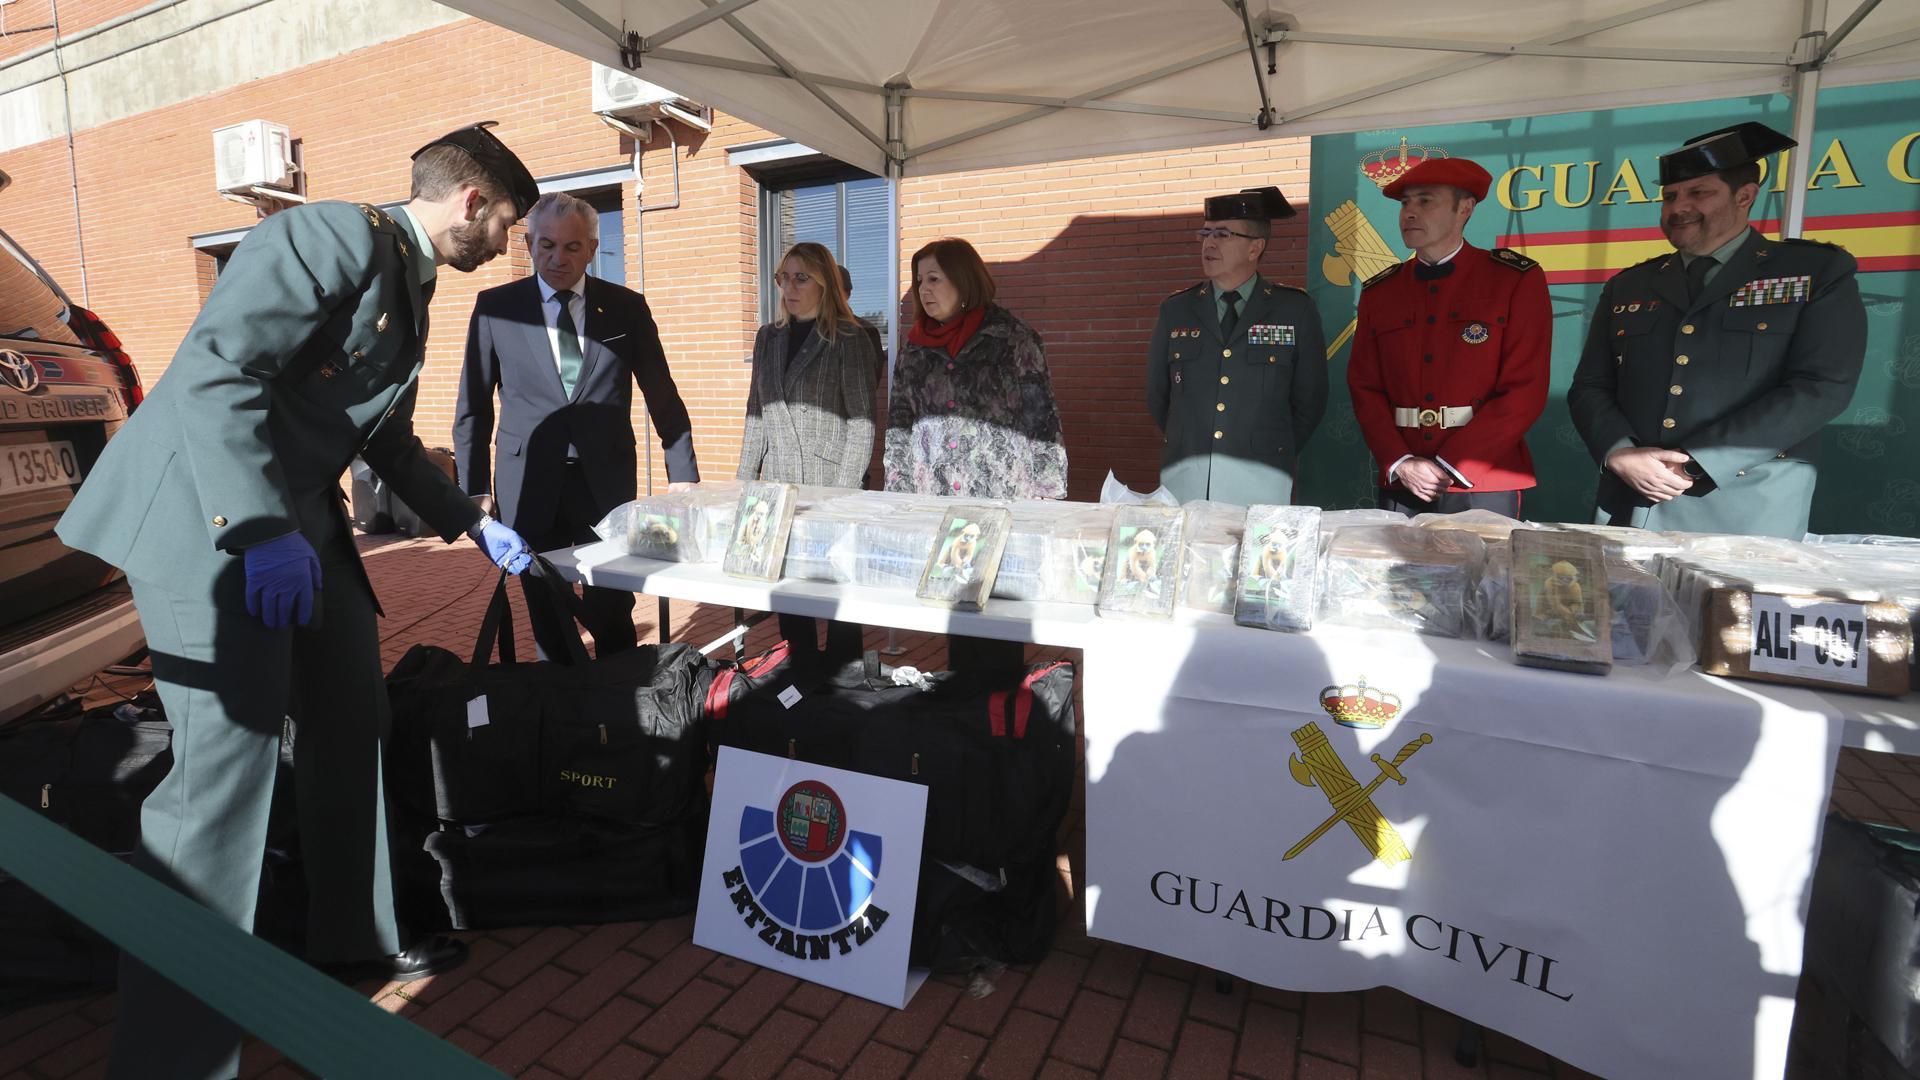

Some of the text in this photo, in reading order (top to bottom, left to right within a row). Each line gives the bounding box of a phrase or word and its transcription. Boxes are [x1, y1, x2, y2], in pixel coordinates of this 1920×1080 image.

[1496, 138, 1864, 212] GUAIA
[26, 398, 106, 419] CRUISER
[1754, 610, 1805, 661] ALF
[560, 769, 617, 789] SPORT
[722, 865, 890, 960] ERTZAINTZA
[1150, 870, 1574, 1002] GUARDIA CIVIL
